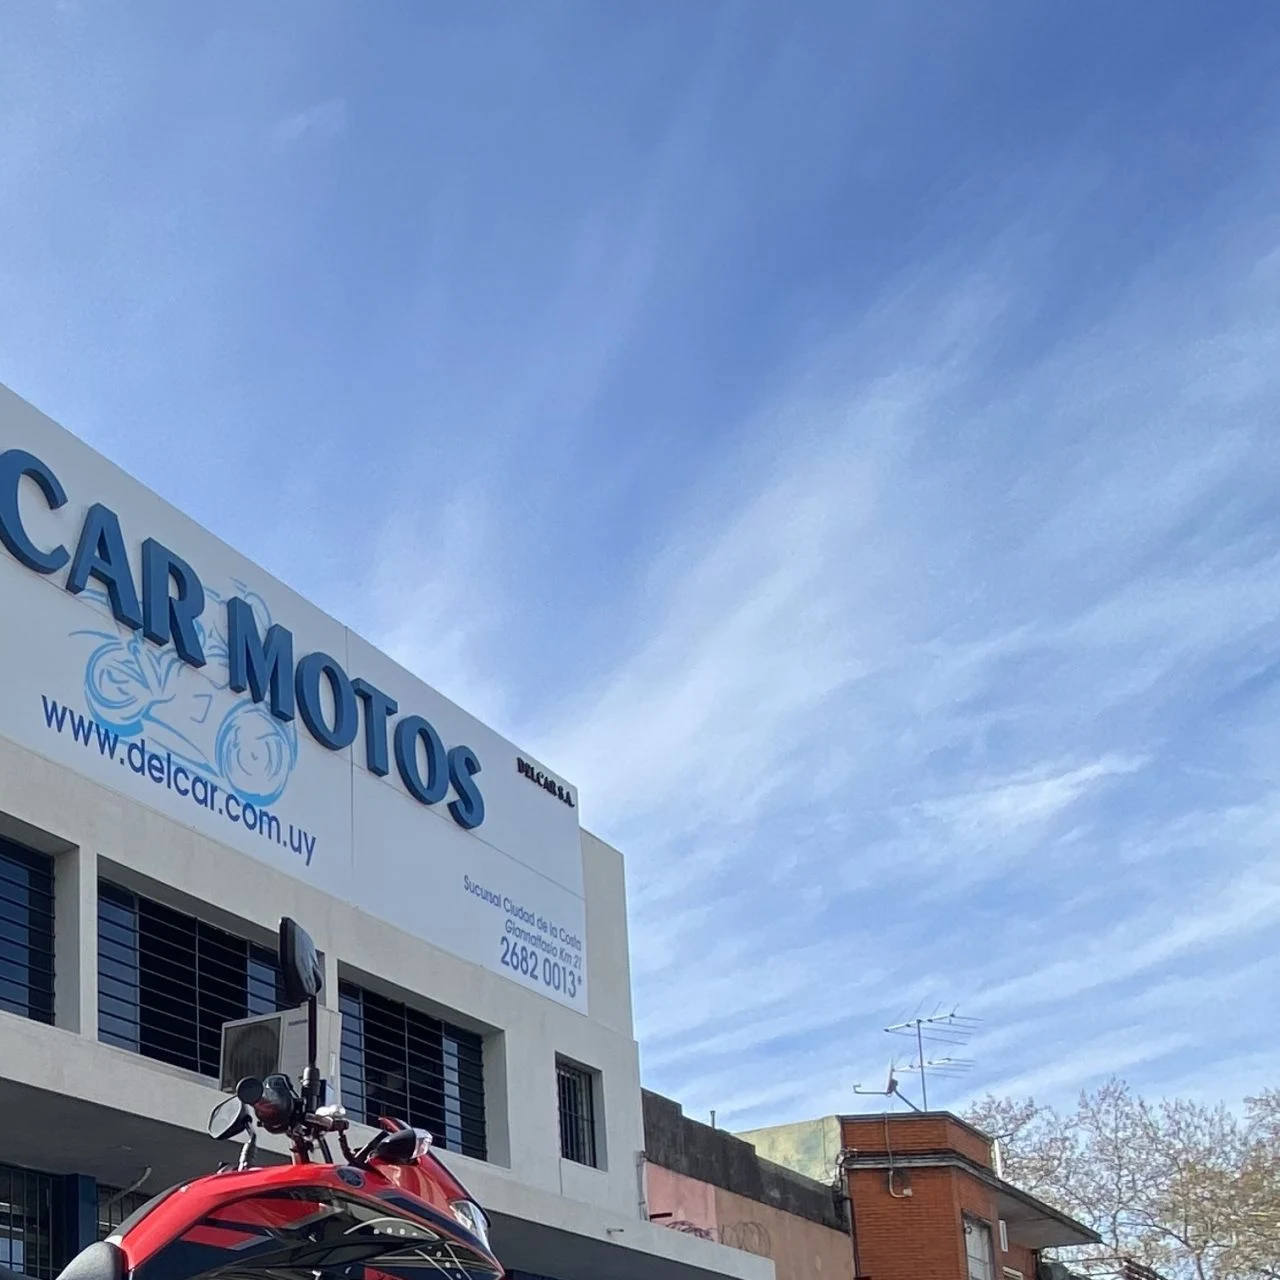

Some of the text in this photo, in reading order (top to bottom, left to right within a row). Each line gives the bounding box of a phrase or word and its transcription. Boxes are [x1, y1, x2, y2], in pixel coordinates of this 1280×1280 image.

[227, 596, 486, 830] MOTOS
[41, 694, 317, 866] www.delcar.com.uy
[516, 757, 557, 797] DELCAR
[463, 874, 582, 951] Sucursal Ciudad de la Costa
[500, 935, 539, 981] 2682
